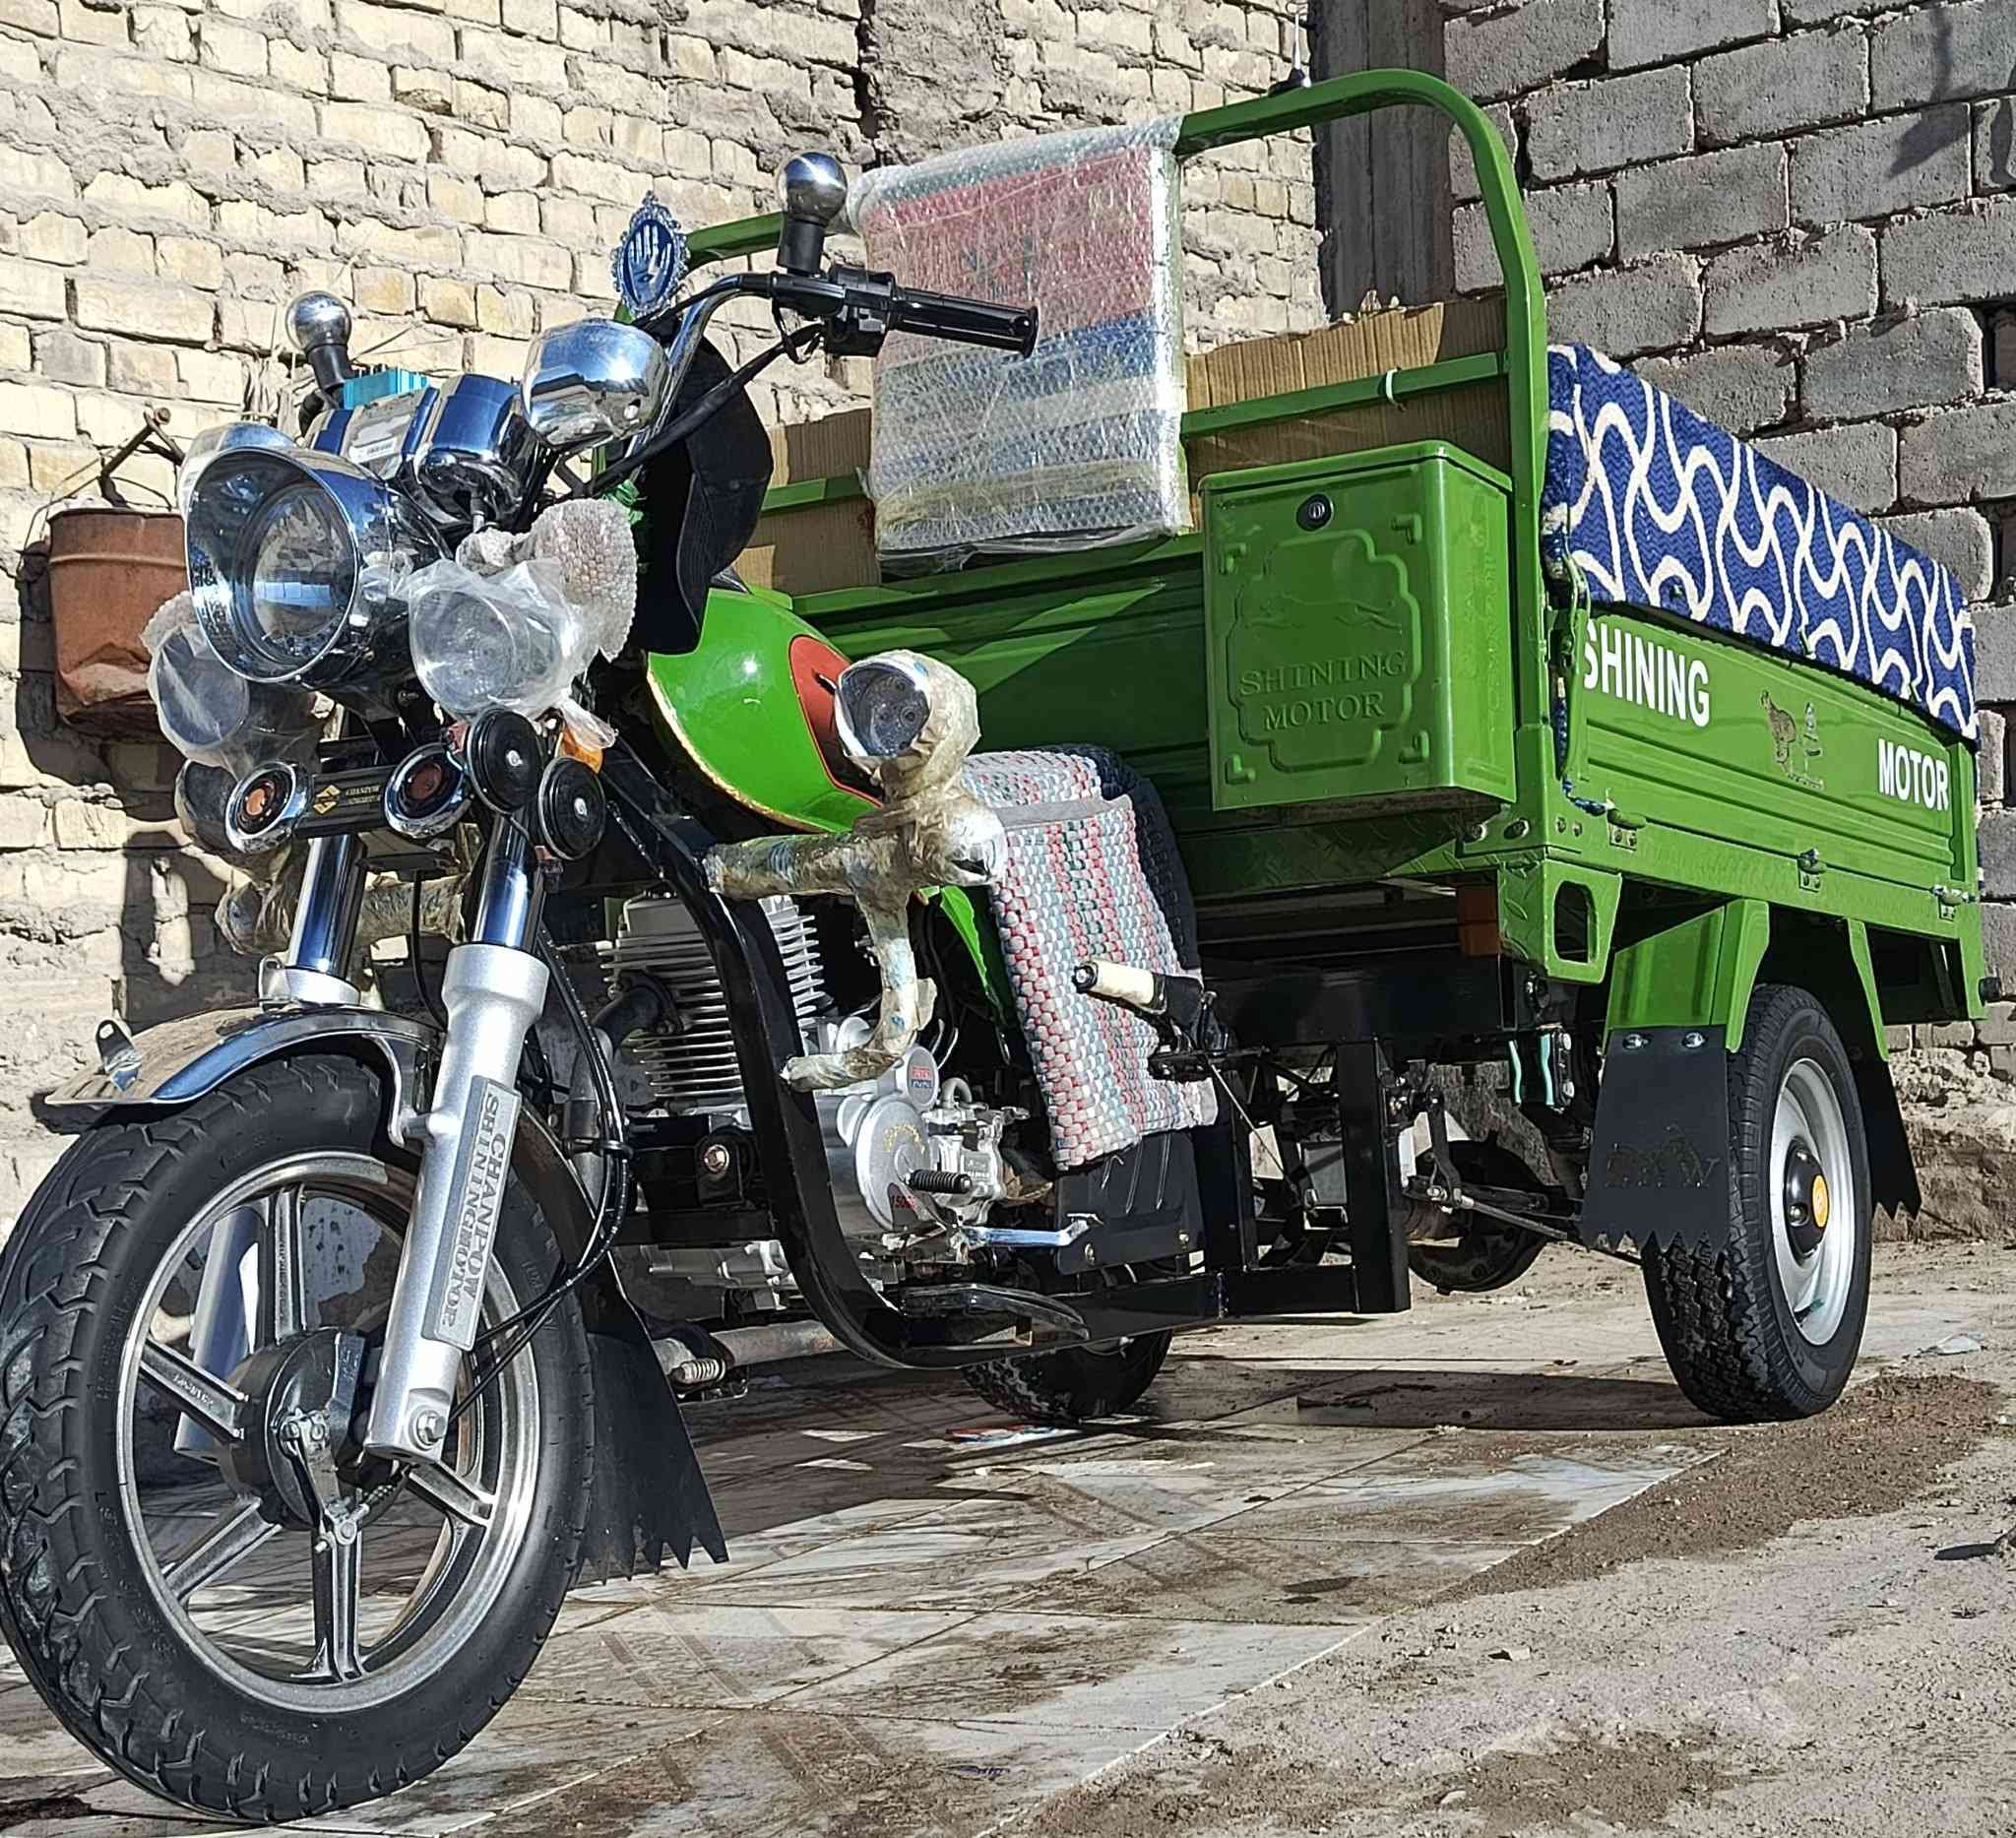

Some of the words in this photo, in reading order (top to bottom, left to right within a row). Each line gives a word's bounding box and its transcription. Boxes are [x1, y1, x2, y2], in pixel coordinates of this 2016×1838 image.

[1238, 650, 1406, 697] SHINING
[1263, 691, 1386, 731] MOTOR
[1584, 618, 1711, 728] SHINING
[1878, 737, 1950, 812] MOTOR
[463, 1132, 507, 1301] CHANPOW
